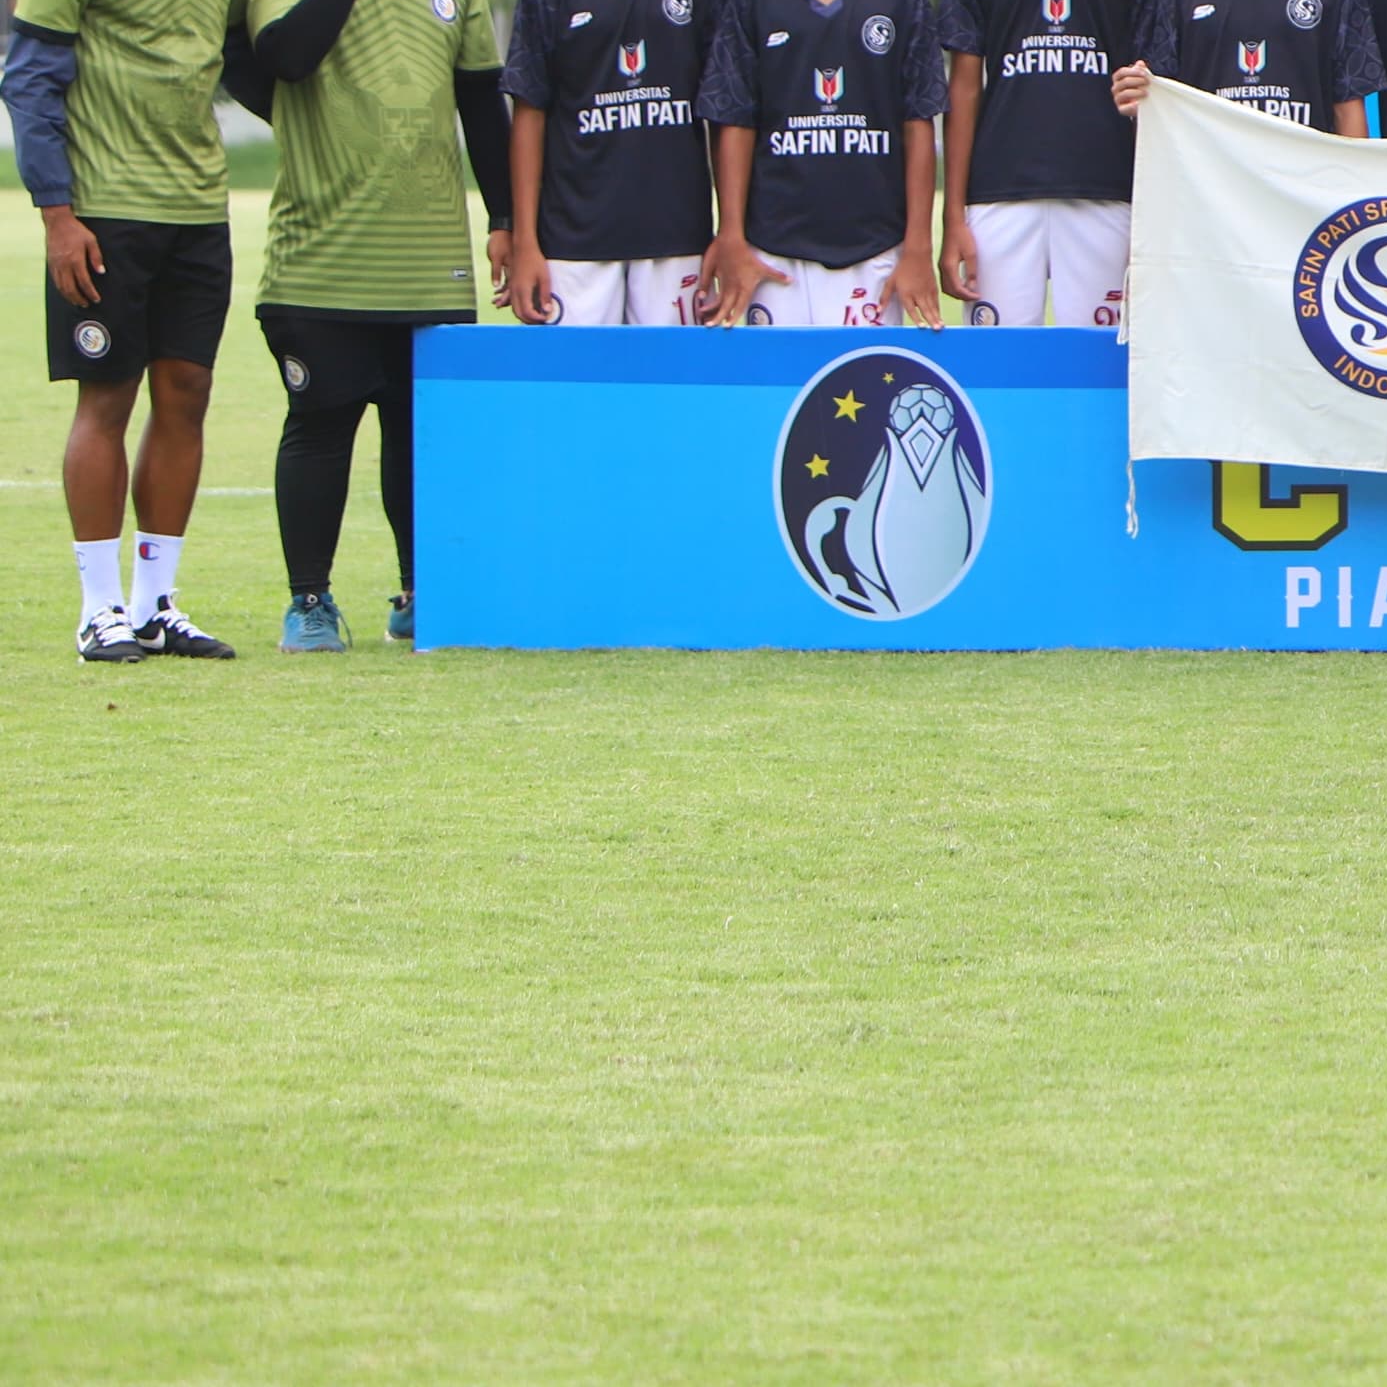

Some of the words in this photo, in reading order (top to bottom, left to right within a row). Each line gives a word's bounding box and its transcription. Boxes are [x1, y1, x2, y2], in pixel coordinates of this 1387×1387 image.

[595, 86, 671, 106] UNIVERSITAS
[578, 102, 642, 134] SAFIN
[788, 115, 867, 128] UNIVERSITAS
[770, 129, 836, 155] SAFIN
[843, 129, 890, 154] PATI
[1298, 249, 1326, 318] SAFIN
[1317, 210, 1361, 248] PATI
